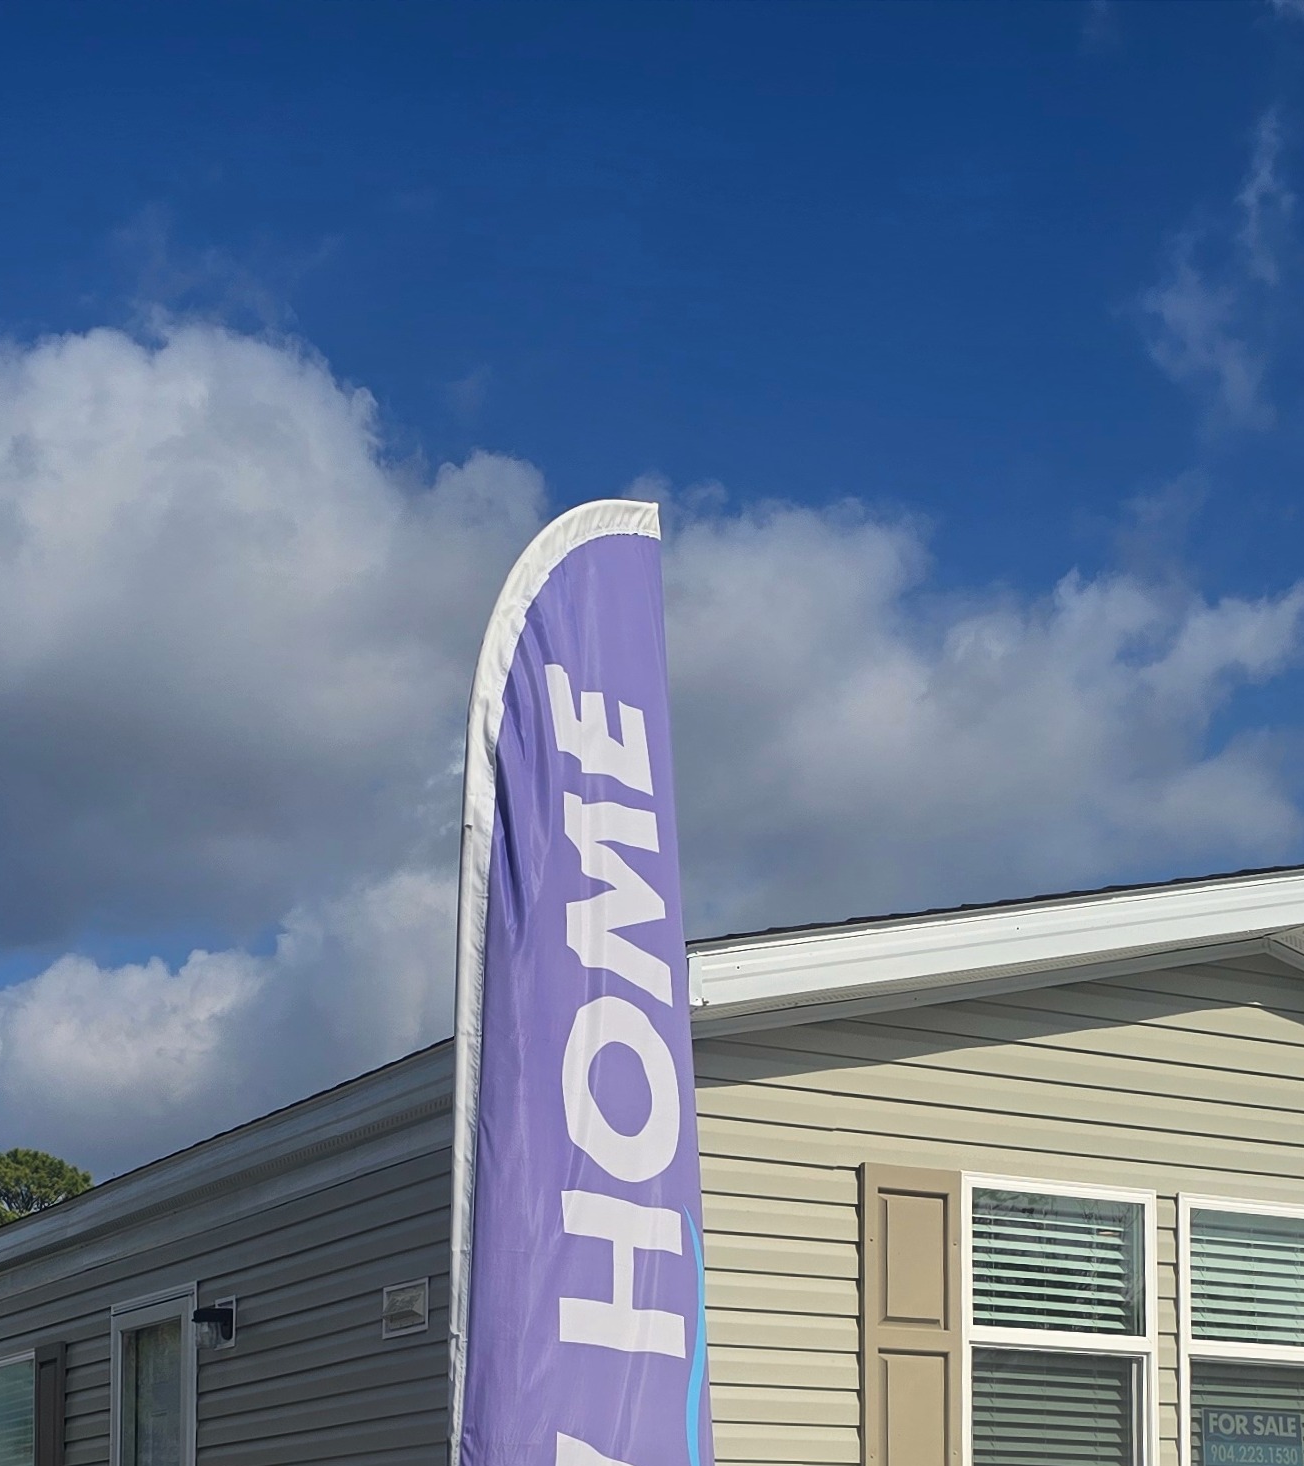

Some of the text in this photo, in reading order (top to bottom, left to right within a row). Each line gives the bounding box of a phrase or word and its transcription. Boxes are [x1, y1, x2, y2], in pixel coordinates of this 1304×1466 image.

[544, 662, 687, 1359] HOME
[1208, 1413, 1297, 1437] FOR SALE
[1211, 1445, 1297, 1465] 904.223.1530
